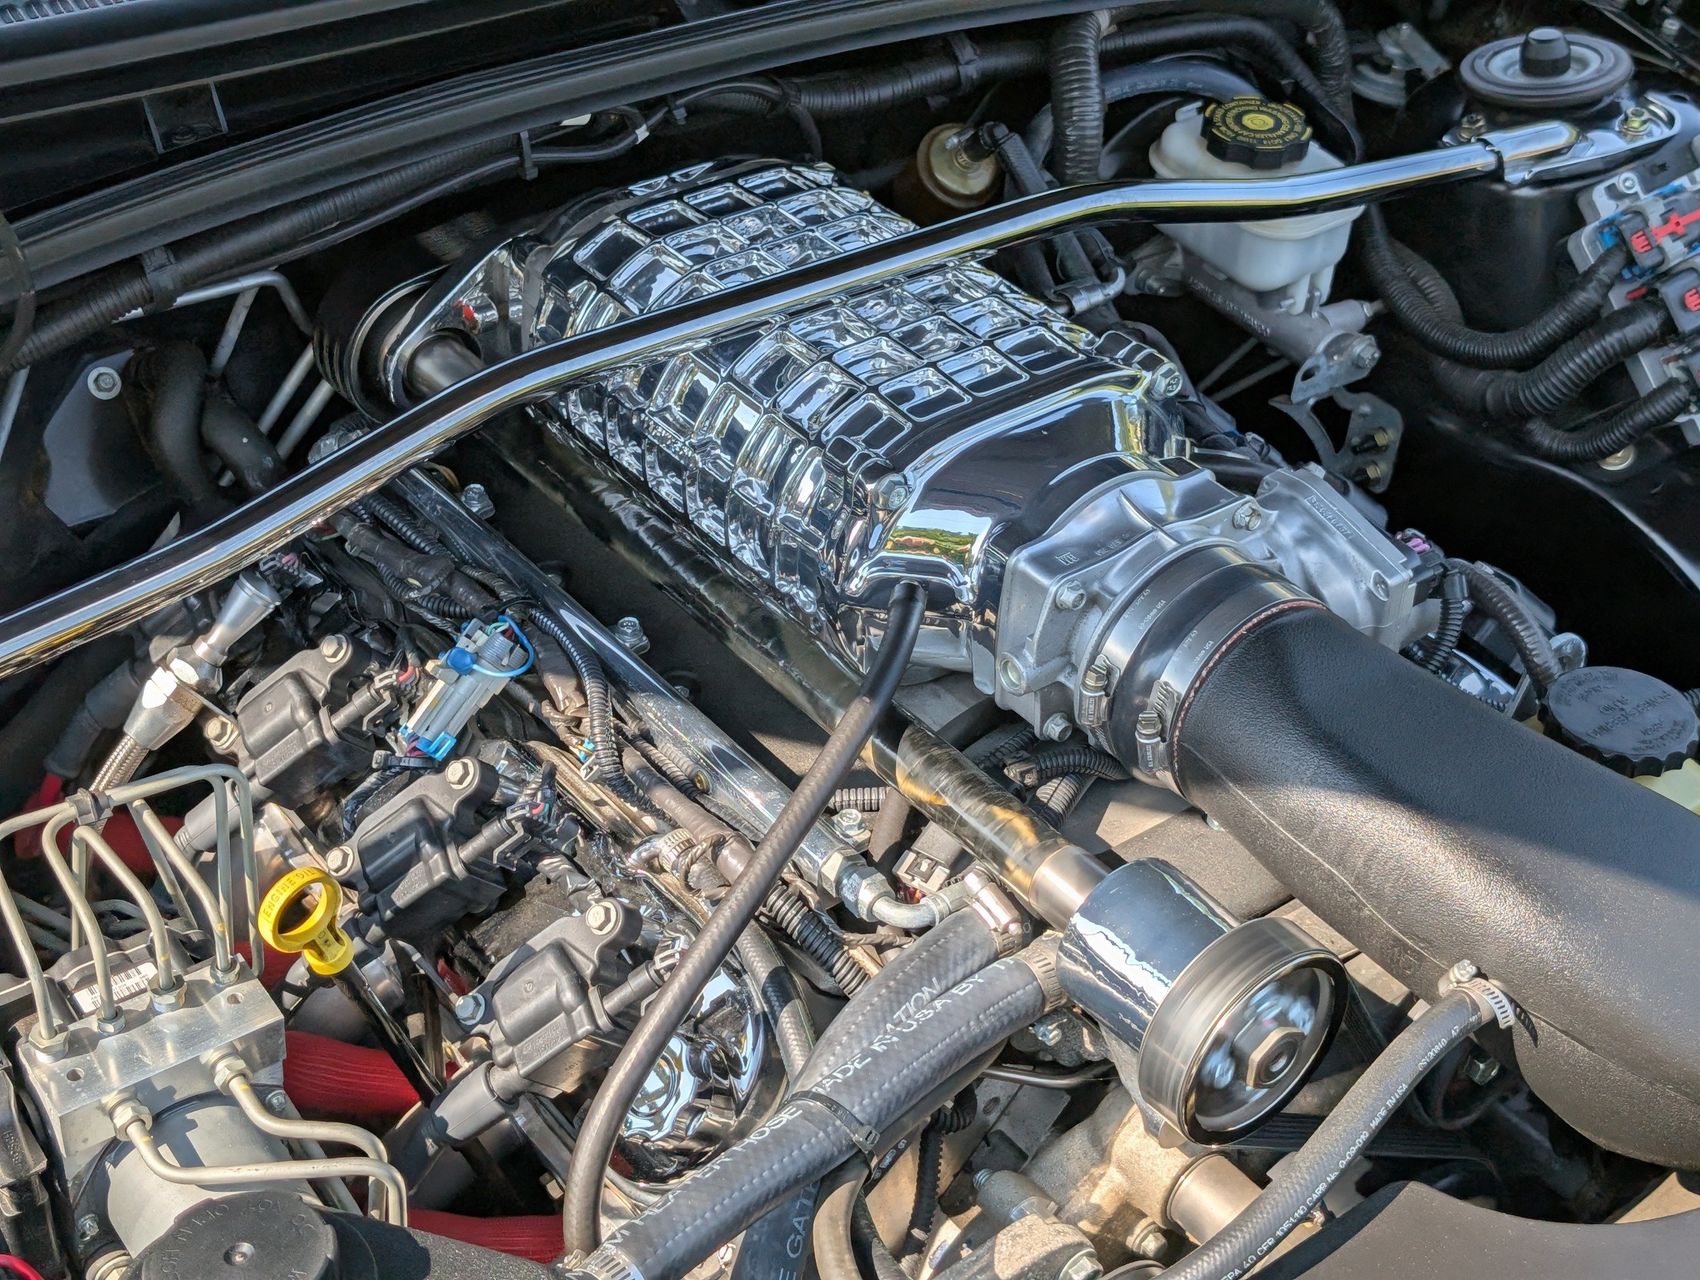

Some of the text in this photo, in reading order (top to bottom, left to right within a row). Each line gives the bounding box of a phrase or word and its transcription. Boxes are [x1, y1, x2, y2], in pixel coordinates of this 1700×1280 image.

[263, 868, 319, 918] ENGINE OIL
[951, 972, 985, 997] BY
[1243, 1254, 1257, 1269] 40
[1256, 1236, 1276, 1256] CFR
[1369, 1106, 1388, 1130] MADE
